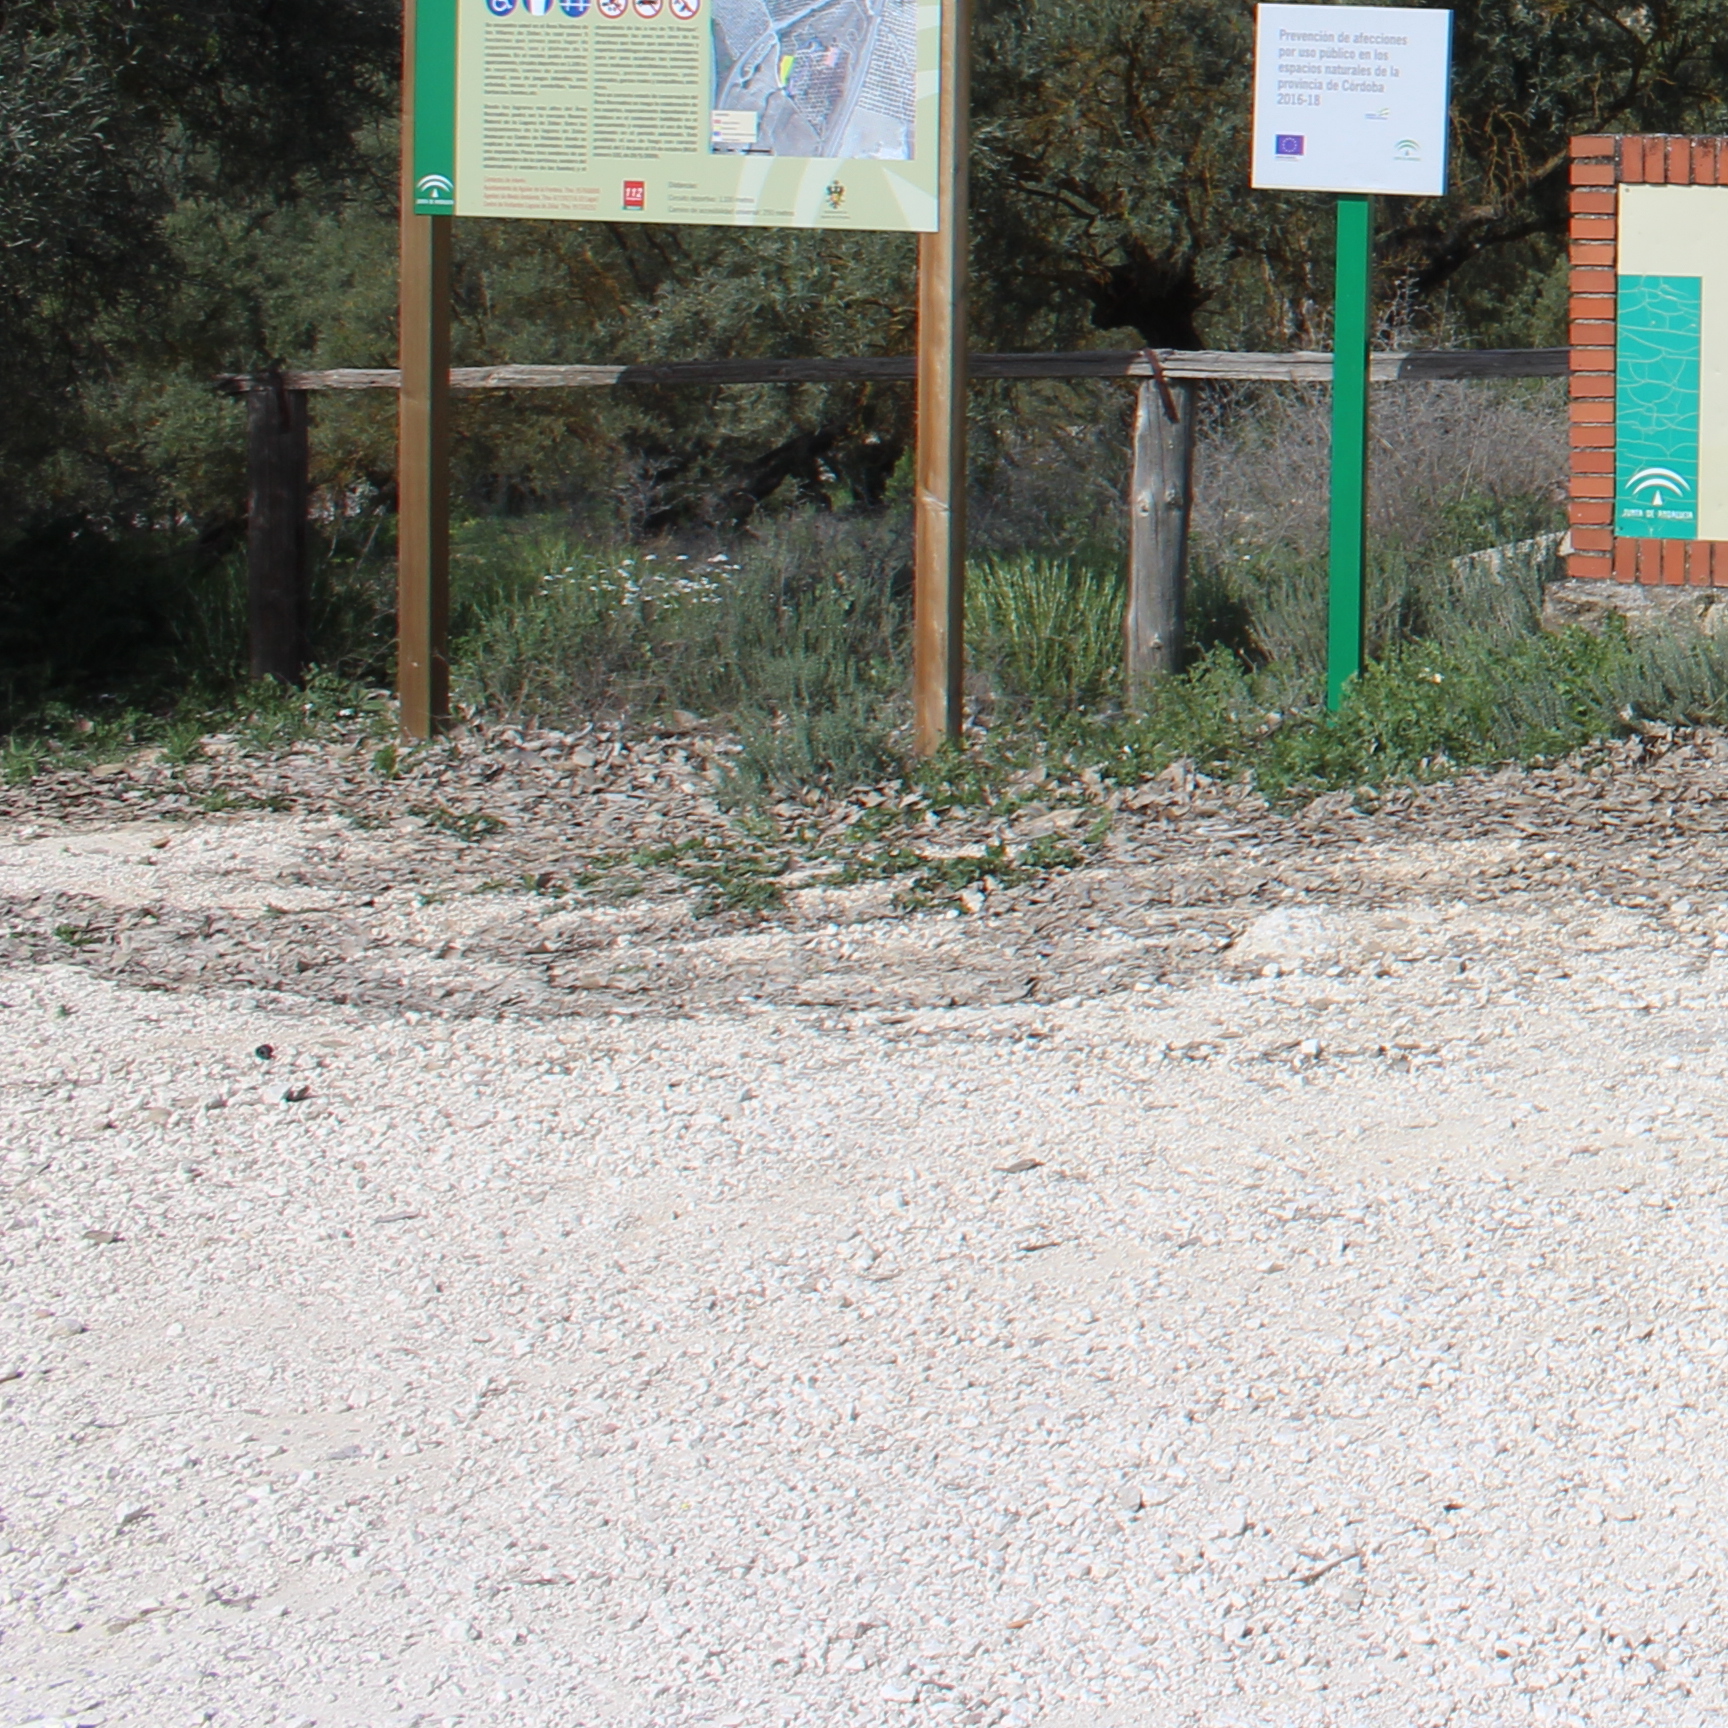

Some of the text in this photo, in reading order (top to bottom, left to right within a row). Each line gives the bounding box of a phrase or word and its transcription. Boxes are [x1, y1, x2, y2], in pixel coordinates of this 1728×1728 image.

[1279, 29, 1408, 45] Prevención de afecciones
[1278, 47, 1388, 61] por uso público en los
[1278, 62, 1399, 77] espacios naturales de la
[1277, 78, 1384, 93] provincia de Córdoba
[1277, 93, 1320, 106] 2016-18
[625, 187, 643, 198] 112
